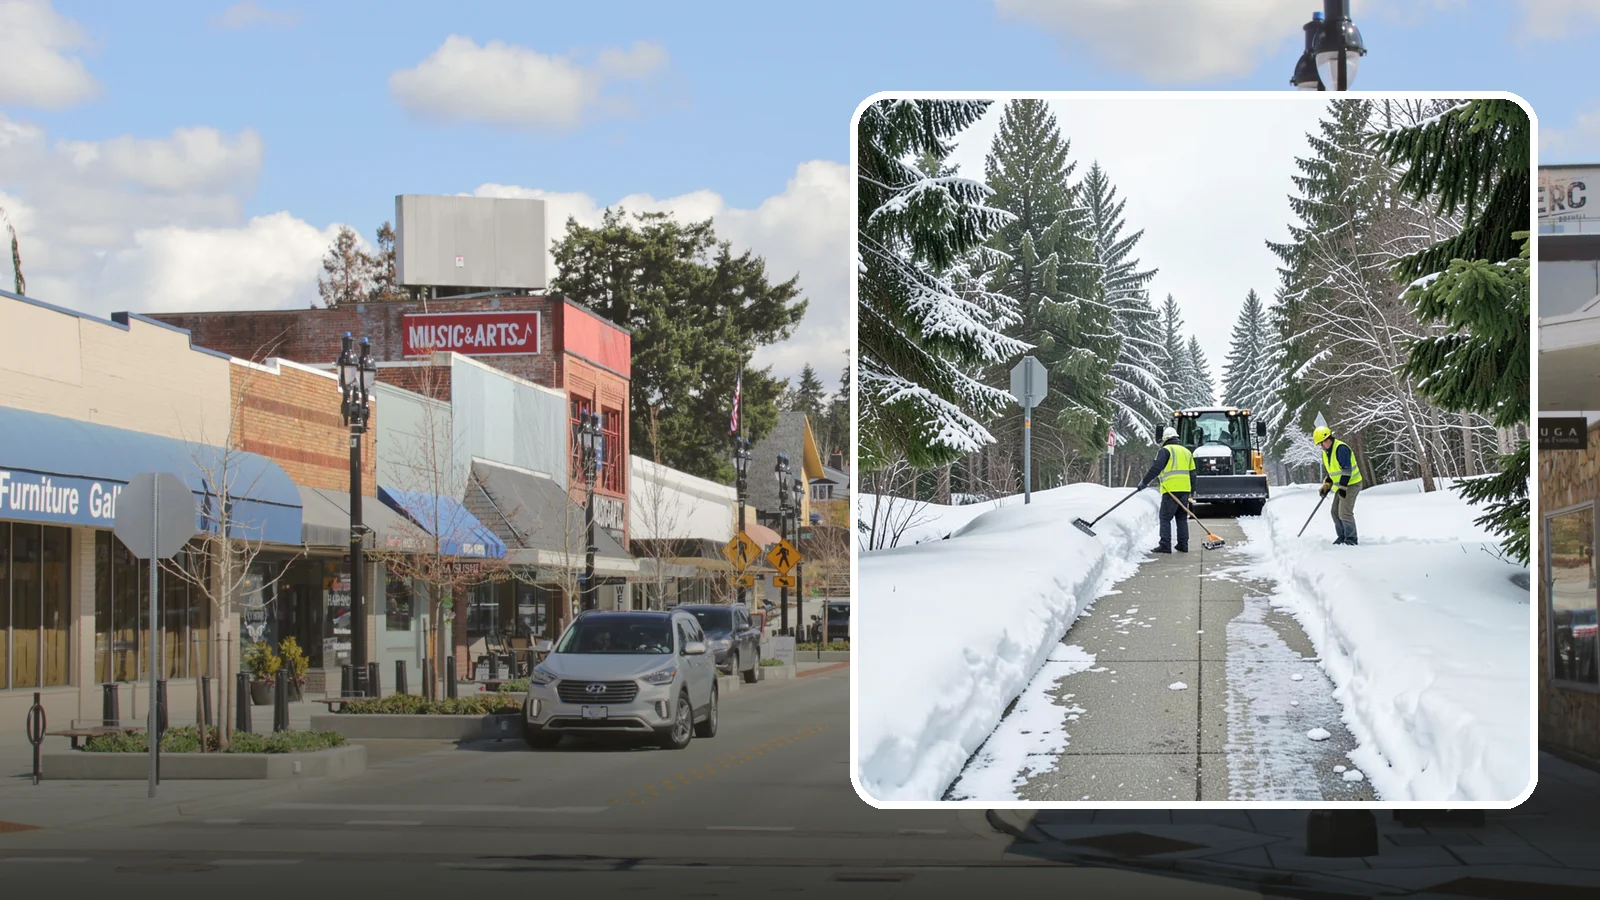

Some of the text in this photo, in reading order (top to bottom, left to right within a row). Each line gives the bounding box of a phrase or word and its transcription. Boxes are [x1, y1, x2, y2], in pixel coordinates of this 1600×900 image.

[409, 322, 520, 349] MUSIC&ARTS
[0, 471, 121, 519] Furniture Gal
[453, 563, 479, 574] SUSHI
